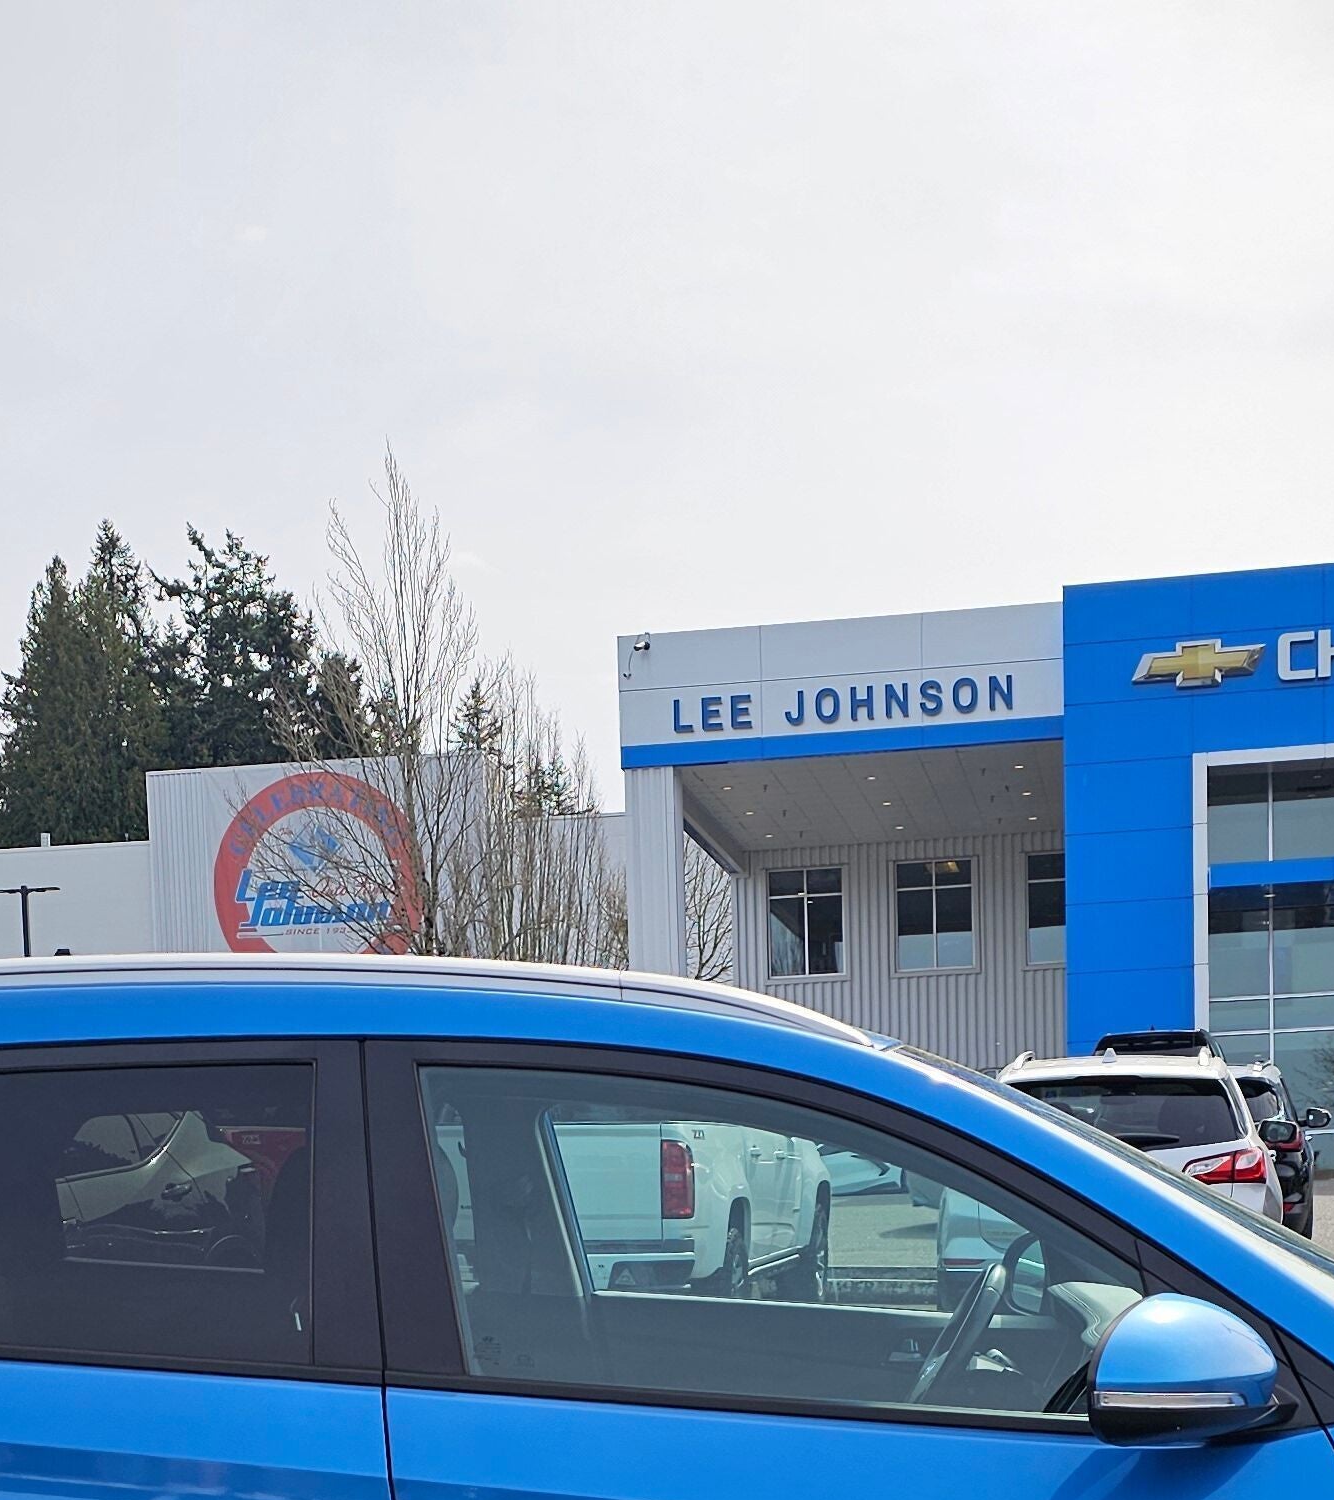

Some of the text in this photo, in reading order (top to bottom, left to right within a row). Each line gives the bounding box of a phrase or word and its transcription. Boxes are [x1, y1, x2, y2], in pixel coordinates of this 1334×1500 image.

[673, 674, 1013, 734] LEE JOHNSON
[236, 869, 304, 902] Lee
[239, 892, 394, 928] Johnson
[285, 927, 320, 936] SINCE
